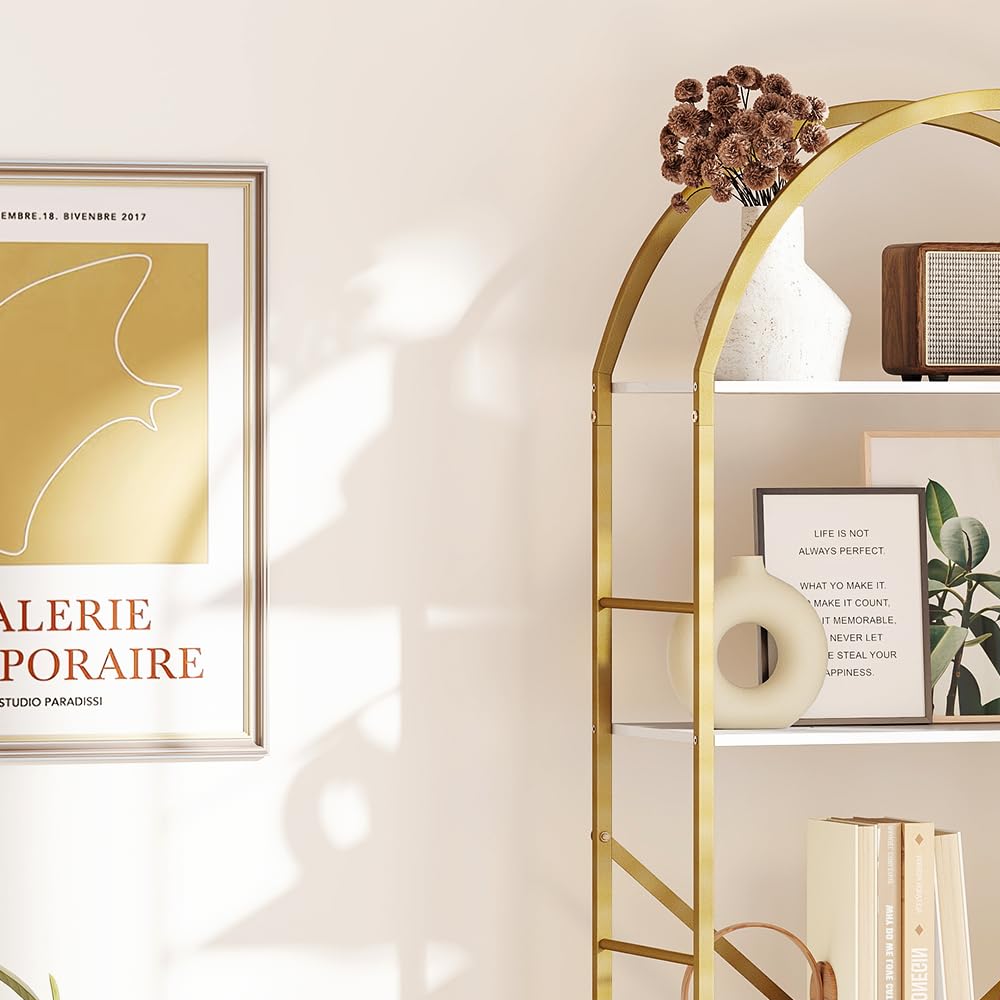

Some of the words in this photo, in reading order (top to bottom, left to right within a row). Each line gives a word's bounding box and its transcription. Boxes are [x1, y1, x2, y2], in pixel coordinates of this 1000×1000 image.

[63, 212, 117, 221] BIVENBRE
[121, 212, 147, 221] 2017
[814, 529, 835, 538] LIFE
[837, 529, 847, 538] IS
[849, 529, 870, 538] NOT
[798, 546, 837, 556] ALWAYS
[839, 546, 886, 556] PERFECT.
[800, 582, 827, 590] WHAT
[829, 582, 844, 590] YO
[846, 582, 873, 590] MAKE
[876, 582, 887, 590] IT.
[814, 599, 841, 608] MAKE
[843, 599, 853, 608] IT
[821, 616, 831, 625] IT
[829, 634, 863, 642] NEVER
[865, 634, 883, 642] LET
[837, 651, 867, 660] STEAL
[869, 650, 897, 659] YOUR
[0, 647, 205, 682] PORAIRE
[44, 696, 103, 707] PARADISSI
